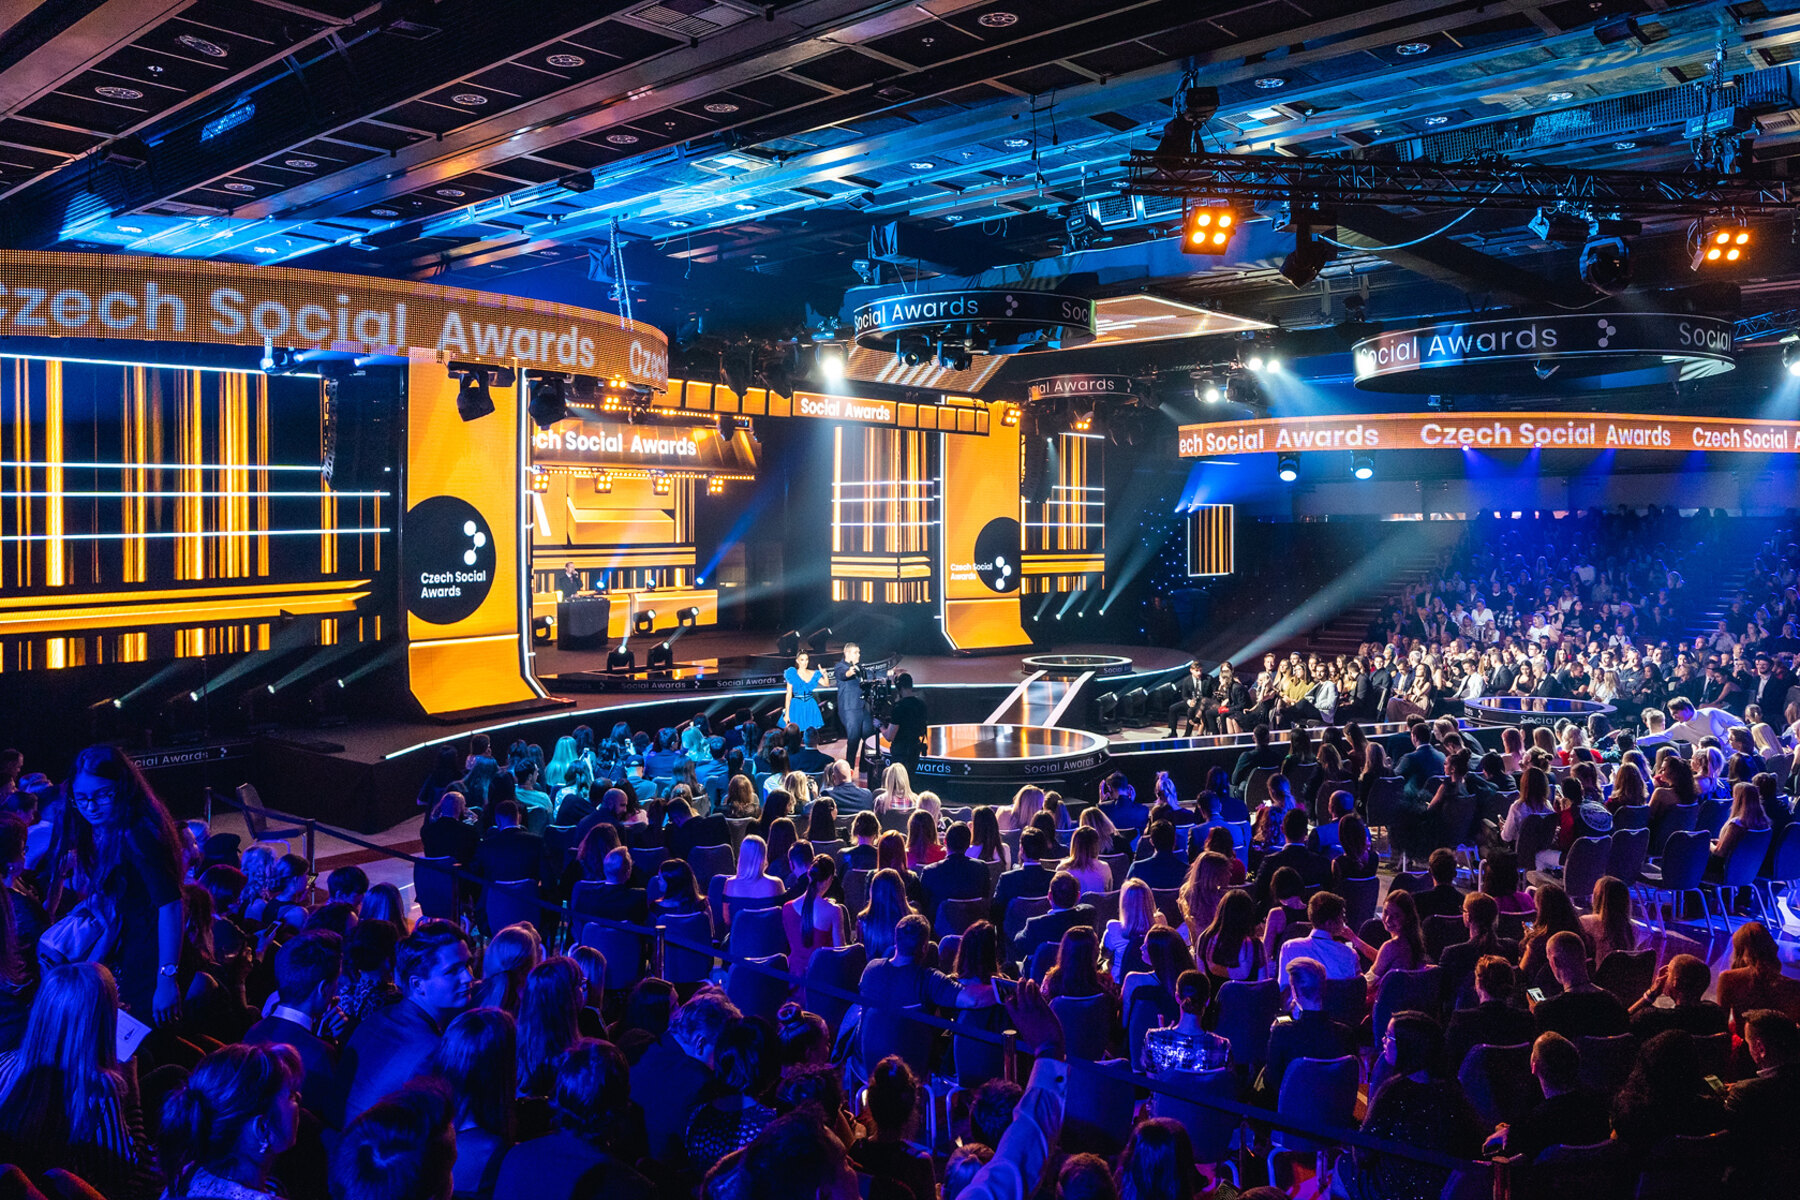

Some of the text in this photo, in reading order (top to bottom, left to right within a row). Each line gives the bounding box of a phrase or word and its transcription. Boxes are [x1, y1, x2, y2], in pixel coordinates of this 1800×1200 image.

[854, 296, 978, 332] Social Awards
[210, 287, 406, 347] Social
[436, 311, 595, 368] Awards
[1680, 322, 1731, 352] Social
[1428, 323, 1557, 356] Awards
[1054, 378, 1115, 393] Awards
[801, 398, 890, 420] Social Awards
[1206, 428, 1264, 452] Social
[1276, 424, 1379, 448] Awards
[1420, 421, 1671, 446] Czech Social Awards
[1692, 427, 1740, 448] Czech
[1743, 428, 1788, 449] Social
[565, 431, 623, 452] Social
[630, 435, 697, 456] Awards
[973, 562, 993, 570] Social
[420, 570, 487, 584] Czech Social
[420, 585, 462, 598] Awards
[652, 681, 686, 689] Awards
[746, 677, 777, 685] Awards
[134, 757, 158, 767] cial
[916, 762, 951, 773] wards
[1024, 757, 1094, 774] Social Awards
